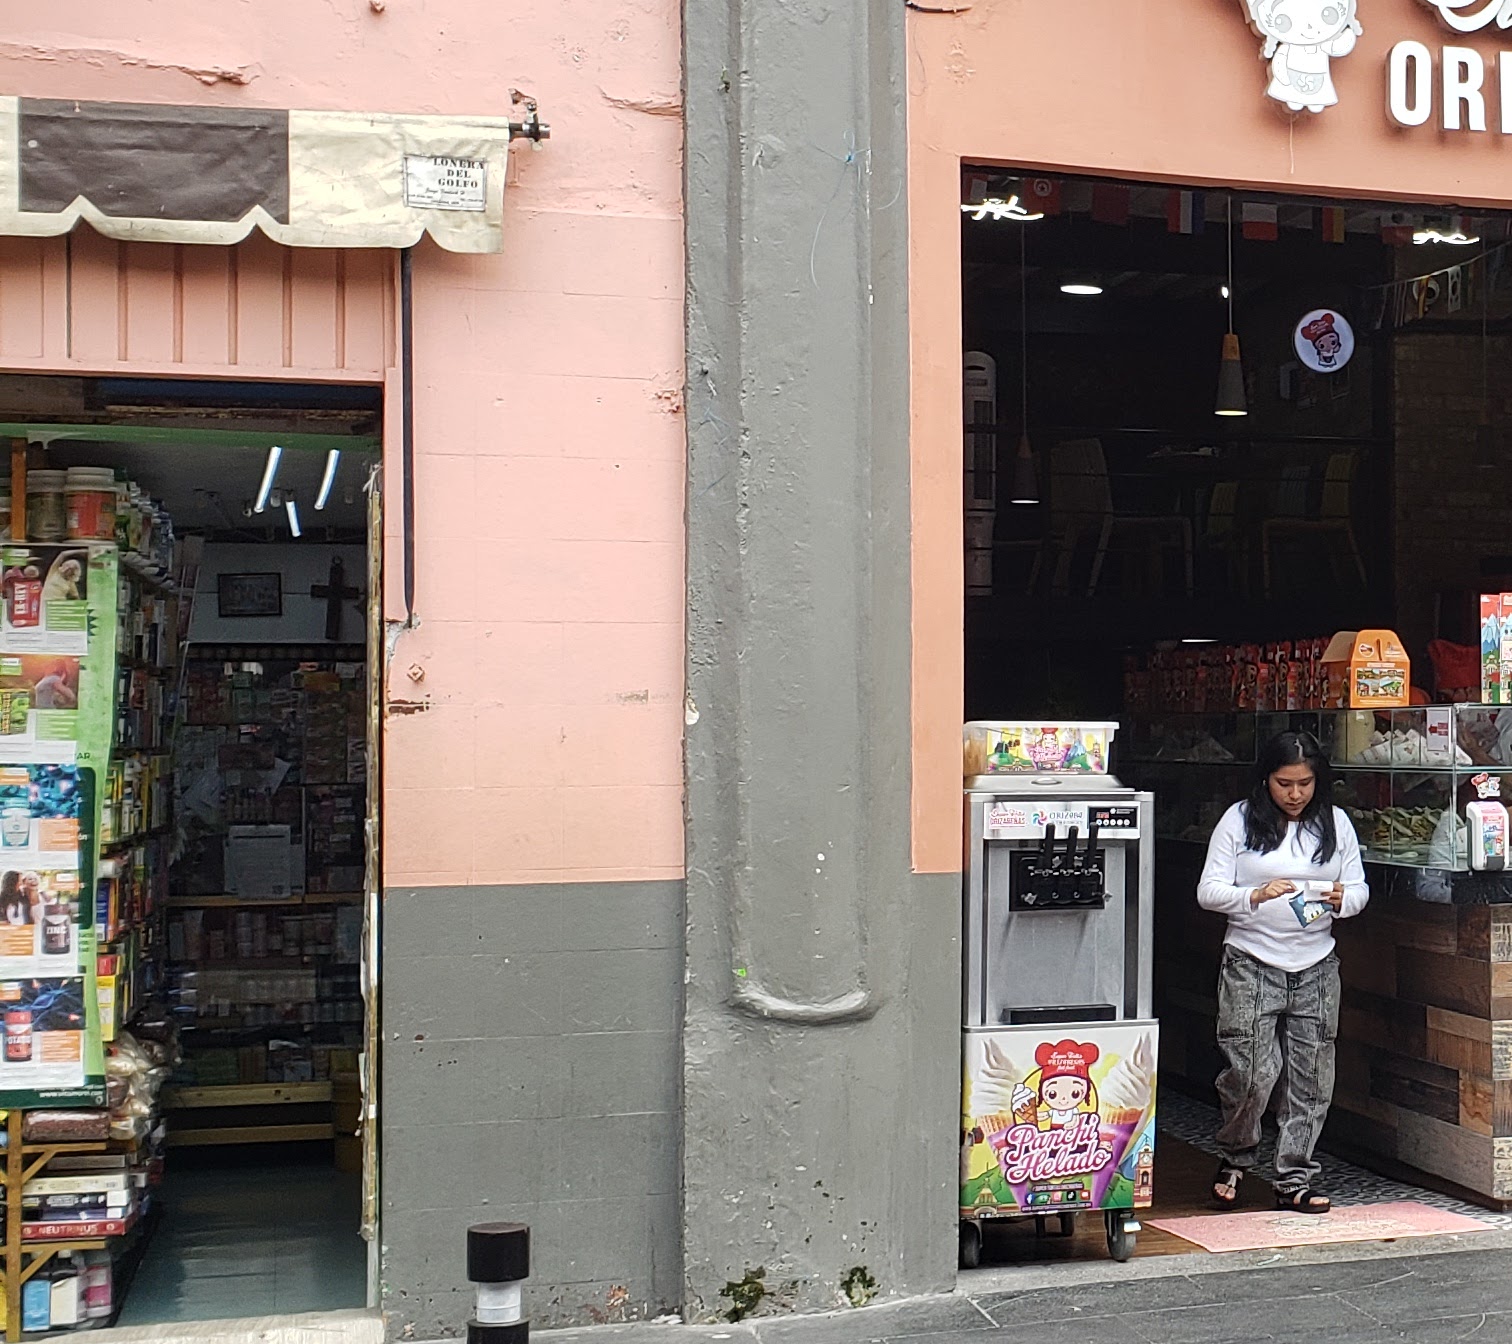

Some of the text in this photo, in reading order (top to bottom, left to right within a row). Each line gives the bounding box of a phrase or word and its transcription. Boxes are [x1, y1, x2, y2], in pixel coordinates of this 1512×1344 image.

[434, 158, 484, 169] LONERA
[447, 169, 471, 178] DEL
[438, 178, 478, 188] GOLFO
[1007, 1114, 1099, 1162] Panchi
[1007, 1141, 1110, 1183] Helado
